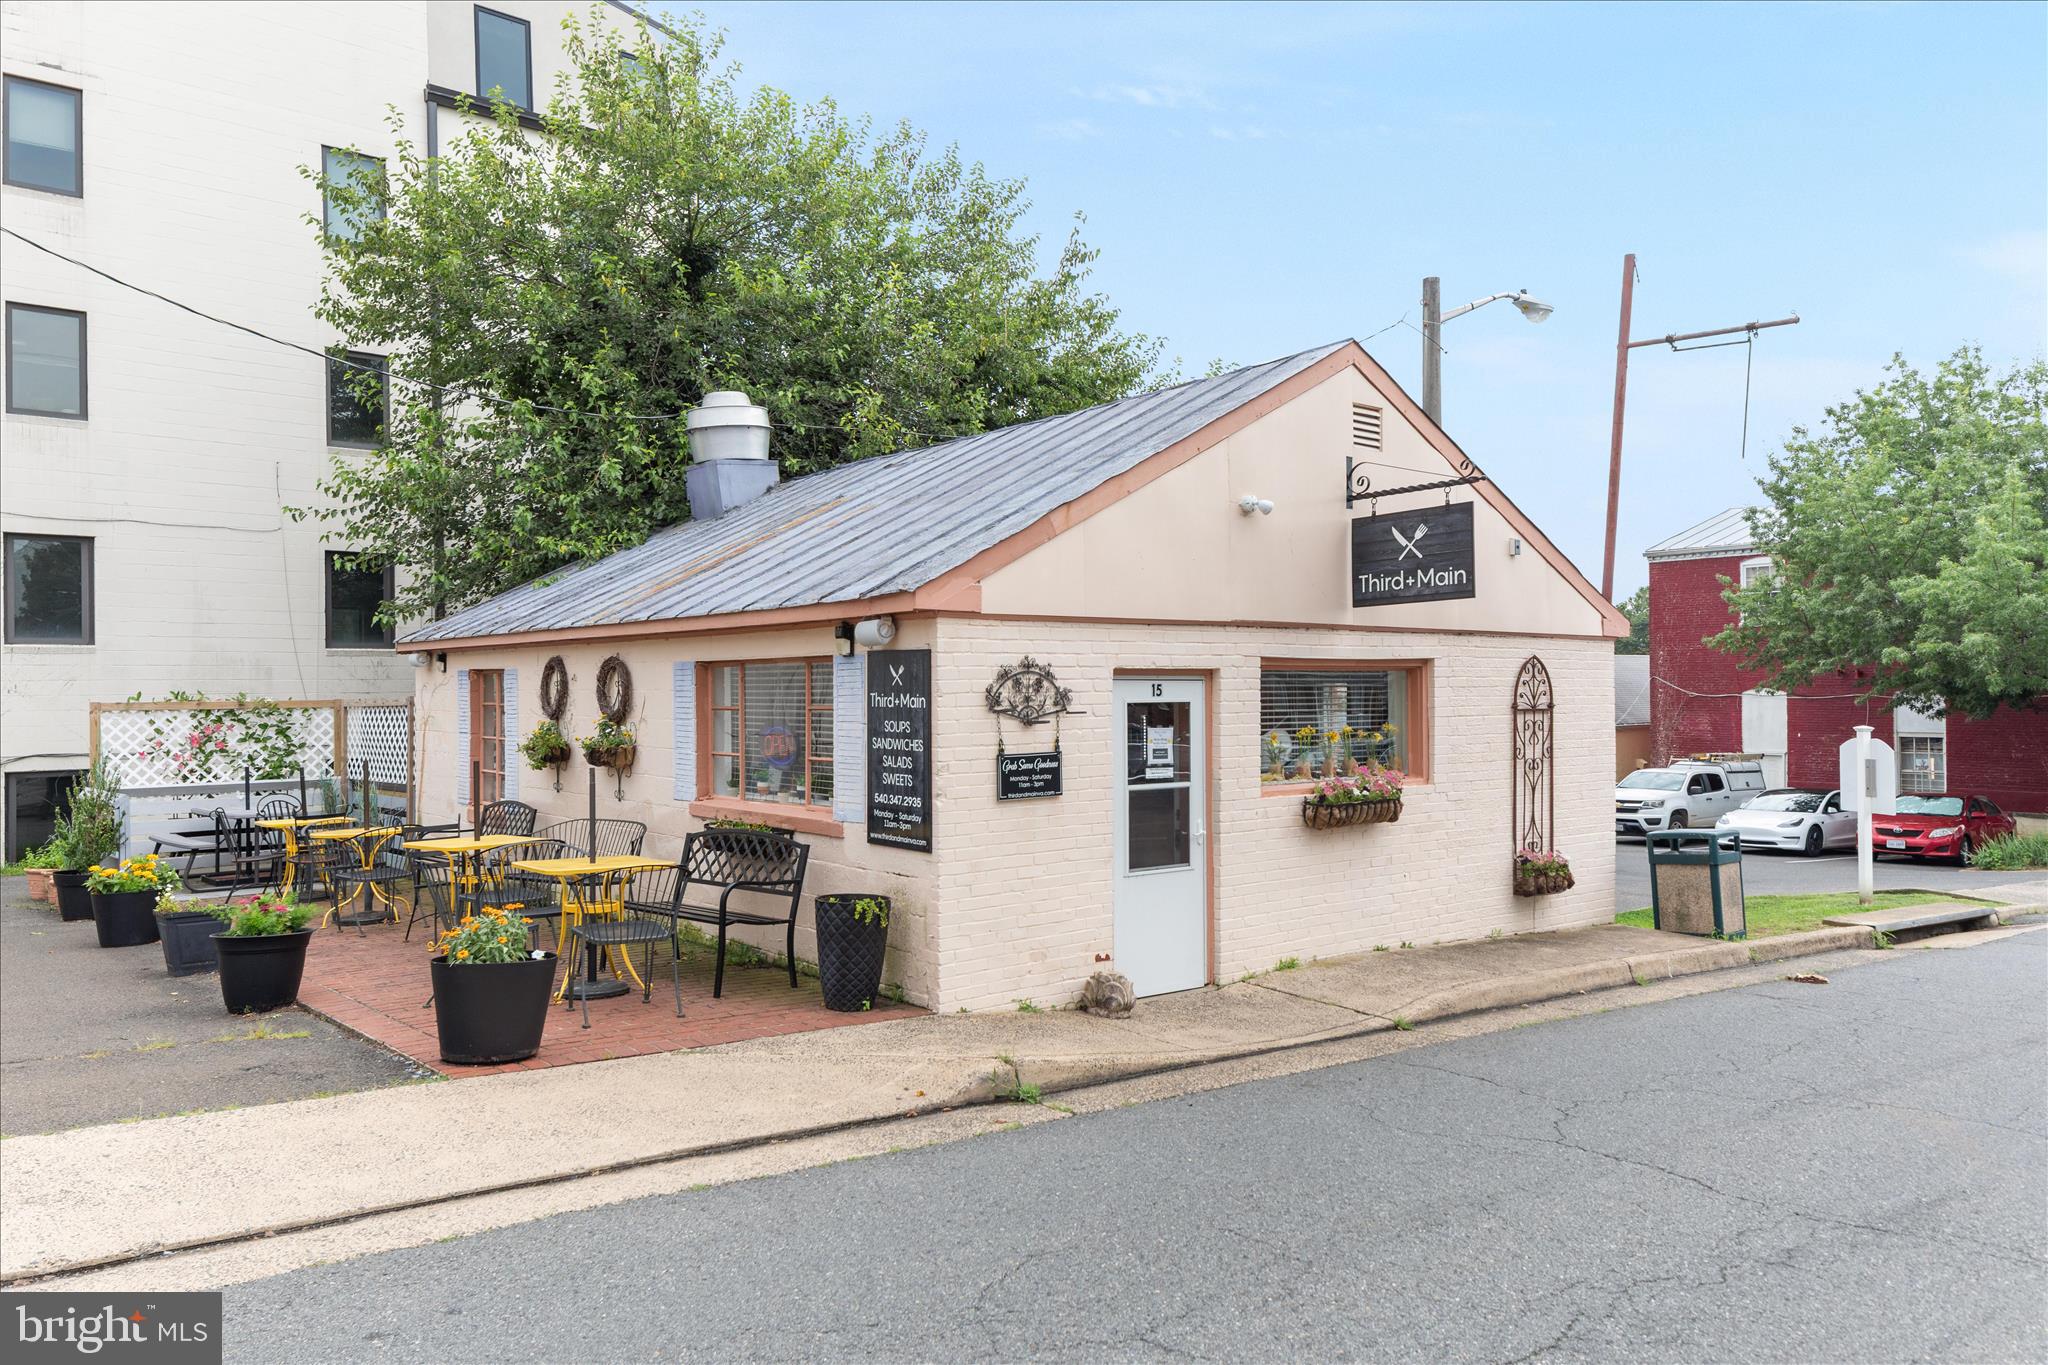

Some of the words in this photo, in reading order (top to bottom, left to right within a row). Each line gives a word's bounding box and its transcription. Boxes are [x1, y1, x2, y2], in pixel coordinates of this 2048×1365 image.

[1358, 566, 1467, 593] Third+Main
[1151, 683, 1163, 697] 15
[870, 692, 926, 710] Third+Main
[884, 720, 911, 734] SOUPS
[763, 734, 794, 756] OPEN
[872, 737, 924, 752] SANDWICHES
[882, 755, 913, 769] SALADS
[882, 773, 913, 787] SWEETS
[874, 793, 922, 808] 540.347.2935
[873, 809, 895, 820] Monday
[898, 811, 922, 824] Saturday
